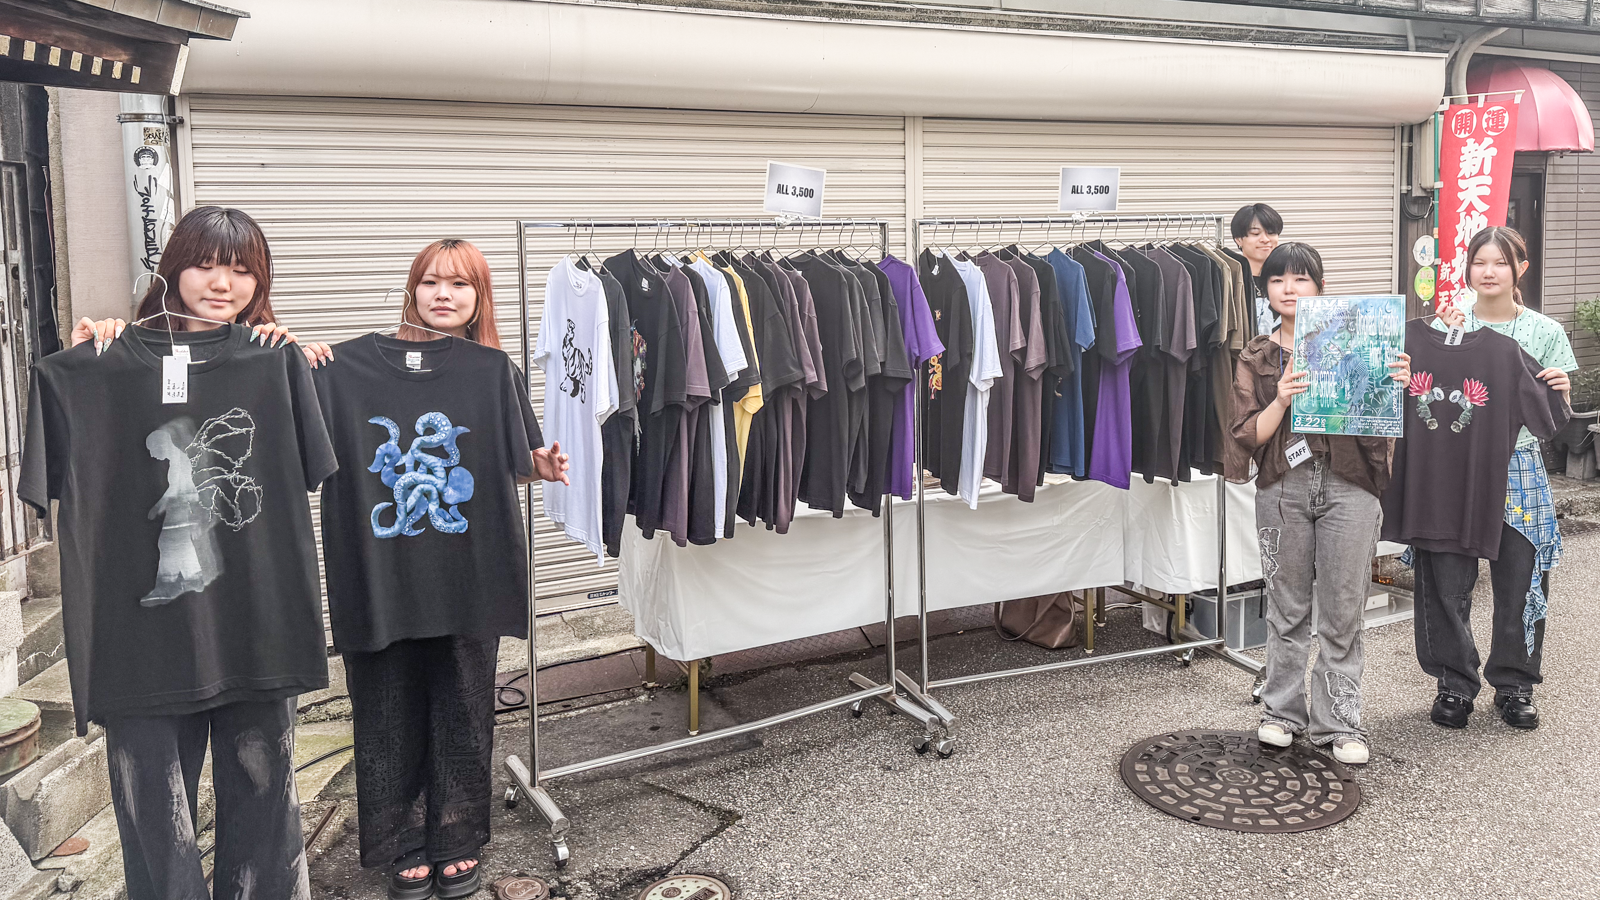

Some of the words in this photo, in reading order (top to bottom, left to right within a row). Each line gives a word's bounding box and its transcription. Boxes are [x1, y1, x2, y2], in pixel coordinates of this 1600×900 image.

[1453, 107, 1508, 136] 開運
[776, 183, 789, 195] ALL
[791, 185, 814, 198] 3,500
[1070, 185, 1084, 195] ALL
[1086, 185, 1109, 196] 3,500
[1451, 137, 1498, 300] 新天地
[1294, 416, 1320, 428] 8.22
[1288, 446, 1306, 462] STAFF
